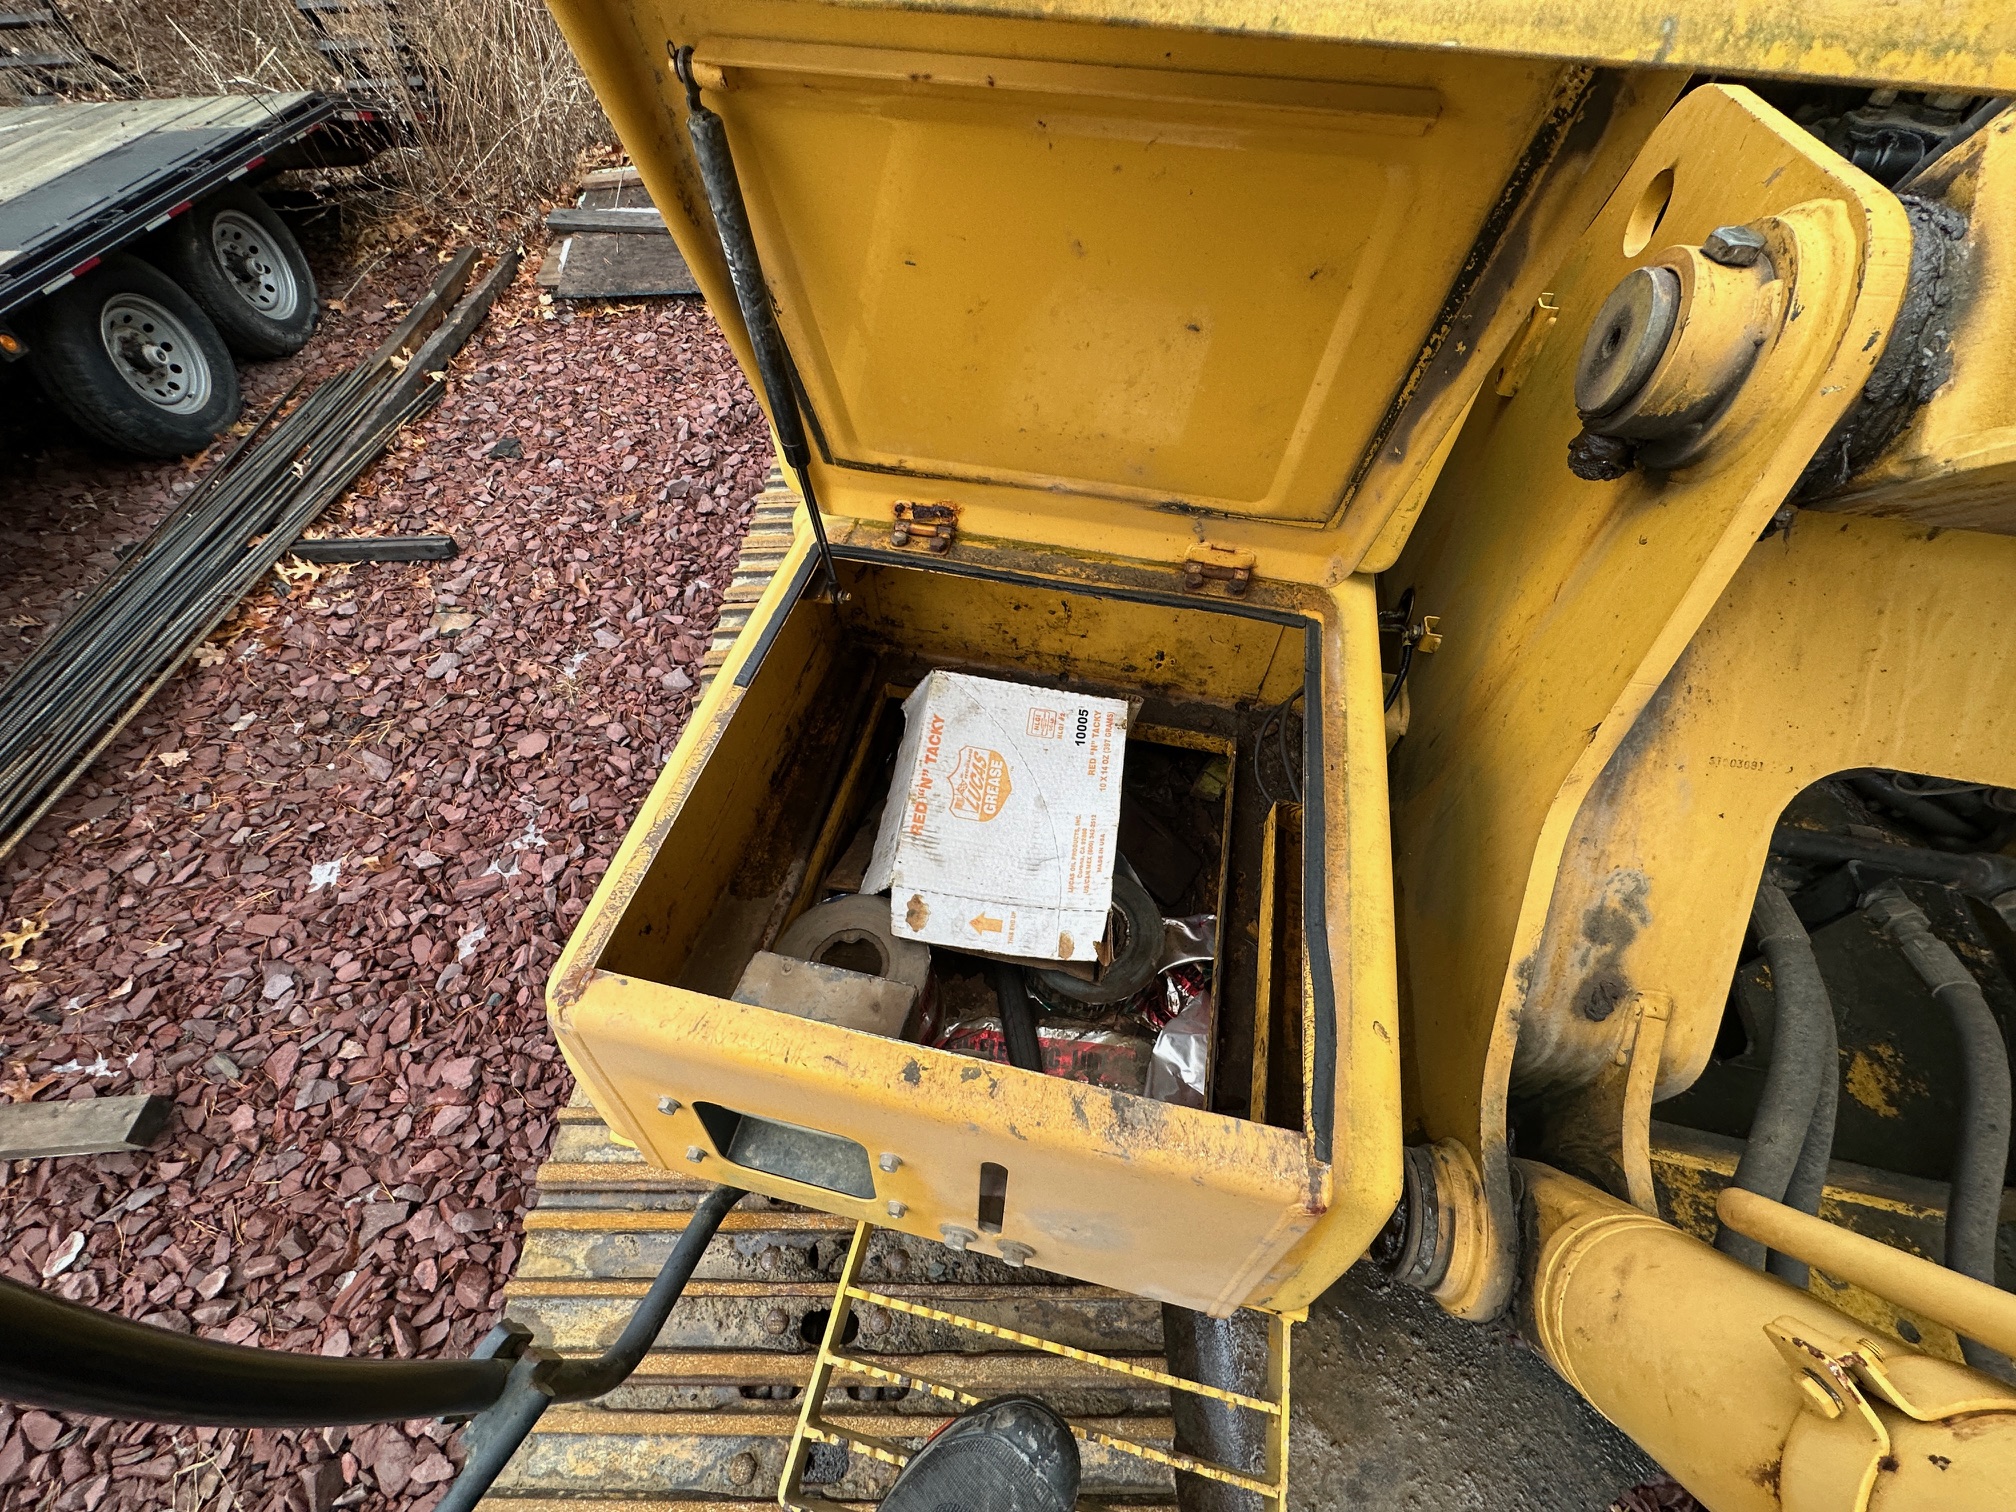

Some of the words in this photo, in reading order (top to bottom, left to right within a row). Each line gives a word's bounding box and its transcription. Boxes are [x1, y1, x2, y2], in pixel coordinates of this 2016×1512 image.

[1075, 709, 1089, 746] 10005
[1092, 711, 1101, 738] TACKY
[1104, 711, 1115, 738] GRAMS)
[1103, 739, 1112, 753] (397
[1088, 758, 1097, 776] RED
[1101, 766, 1108, 775] 14
[1102, 755, 1109, 764] OZ
[910, 802, 928, 835] RED
[925, 714, 945, 765] TACKY
[965, 751, 987, 812] LUCAS
[984, 759, 1003, 814] GREASE
[1099, 783, 1106, 792] 10
[1071, 827, 1080, 860] PRODUCTS,
[1080, 846, 1085, 854] CA
[1077, 856, 1085, 878] Corona,
[1011, 911, 1016, 919] UP
